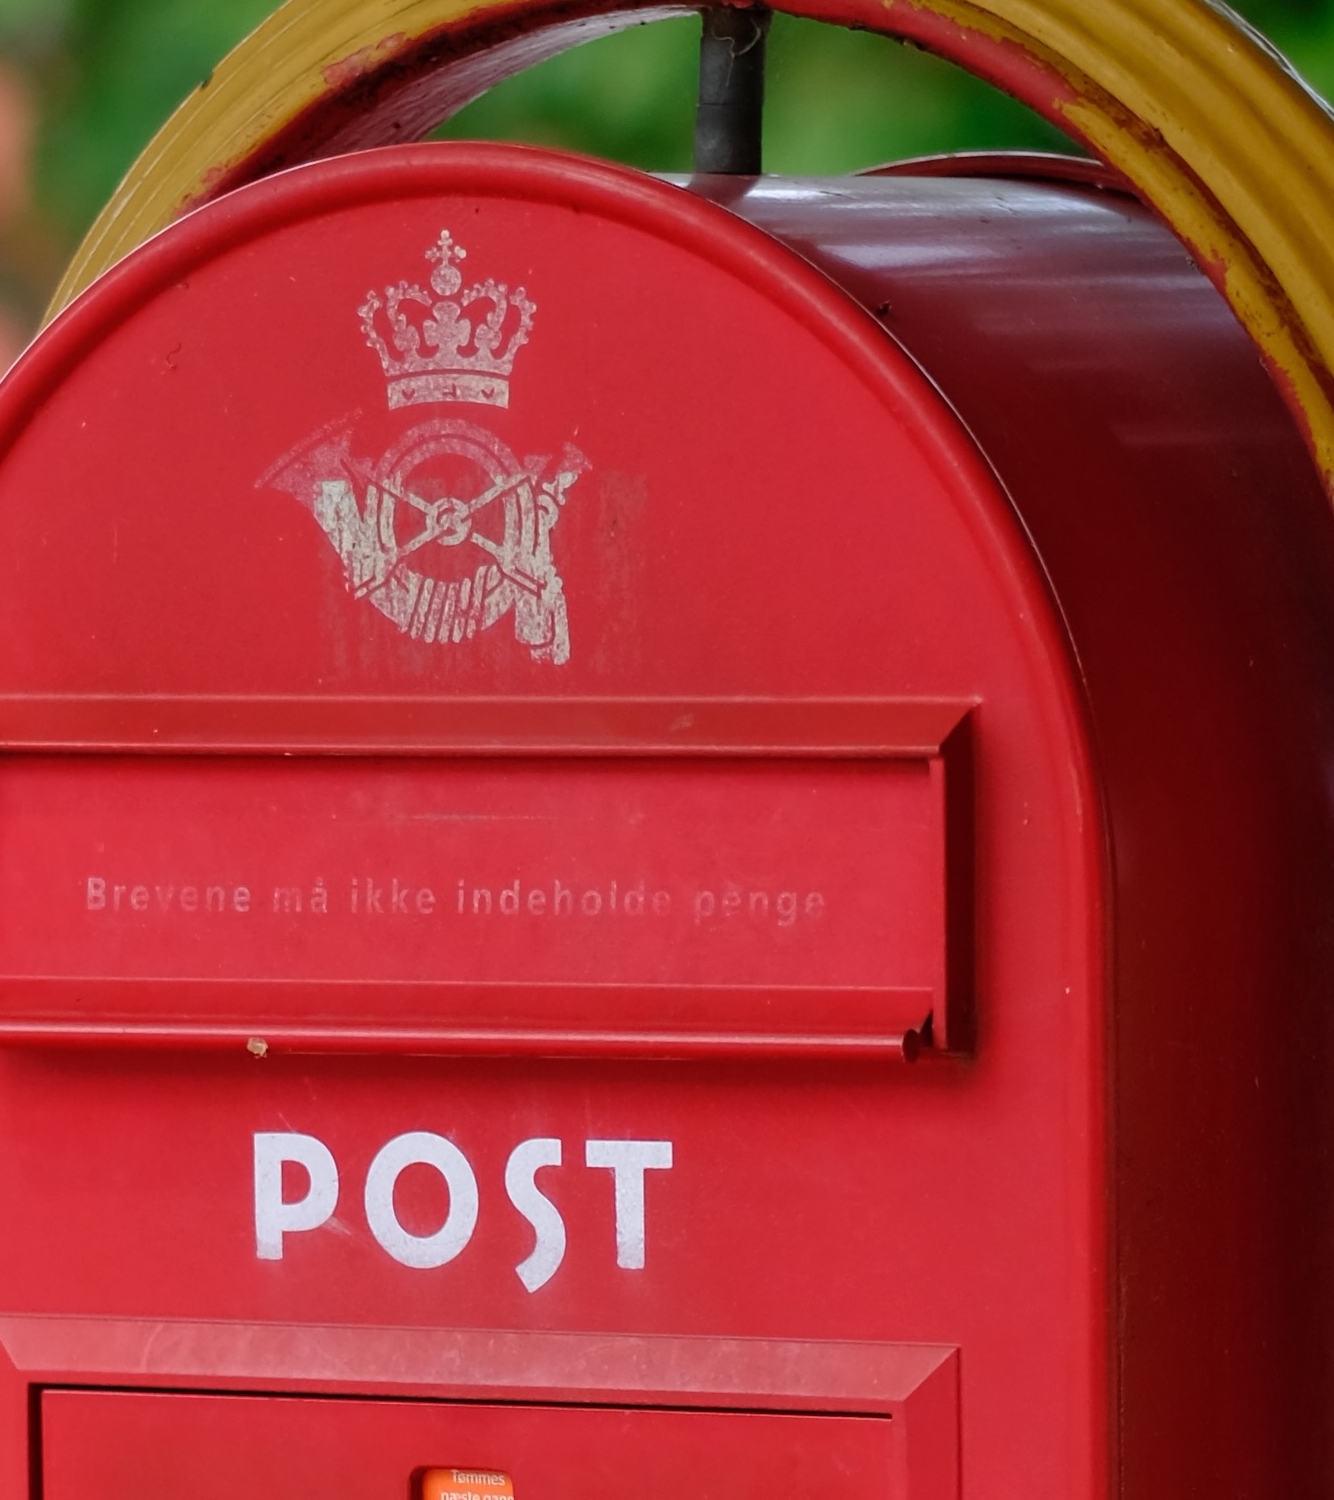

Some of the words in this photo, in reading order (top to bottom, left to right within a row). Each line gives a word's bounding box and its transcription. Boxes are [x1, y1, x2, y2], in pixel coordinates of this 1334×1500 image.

[86, 876, 252, 913] Brevene
[272, 876, 329, 913] må
[350, 876, 436, 914] ikke
[456, 879, 672, 916] indeholde
[693, 886, 826, 927] penge
[254, 1131, 673, 1293] POST
